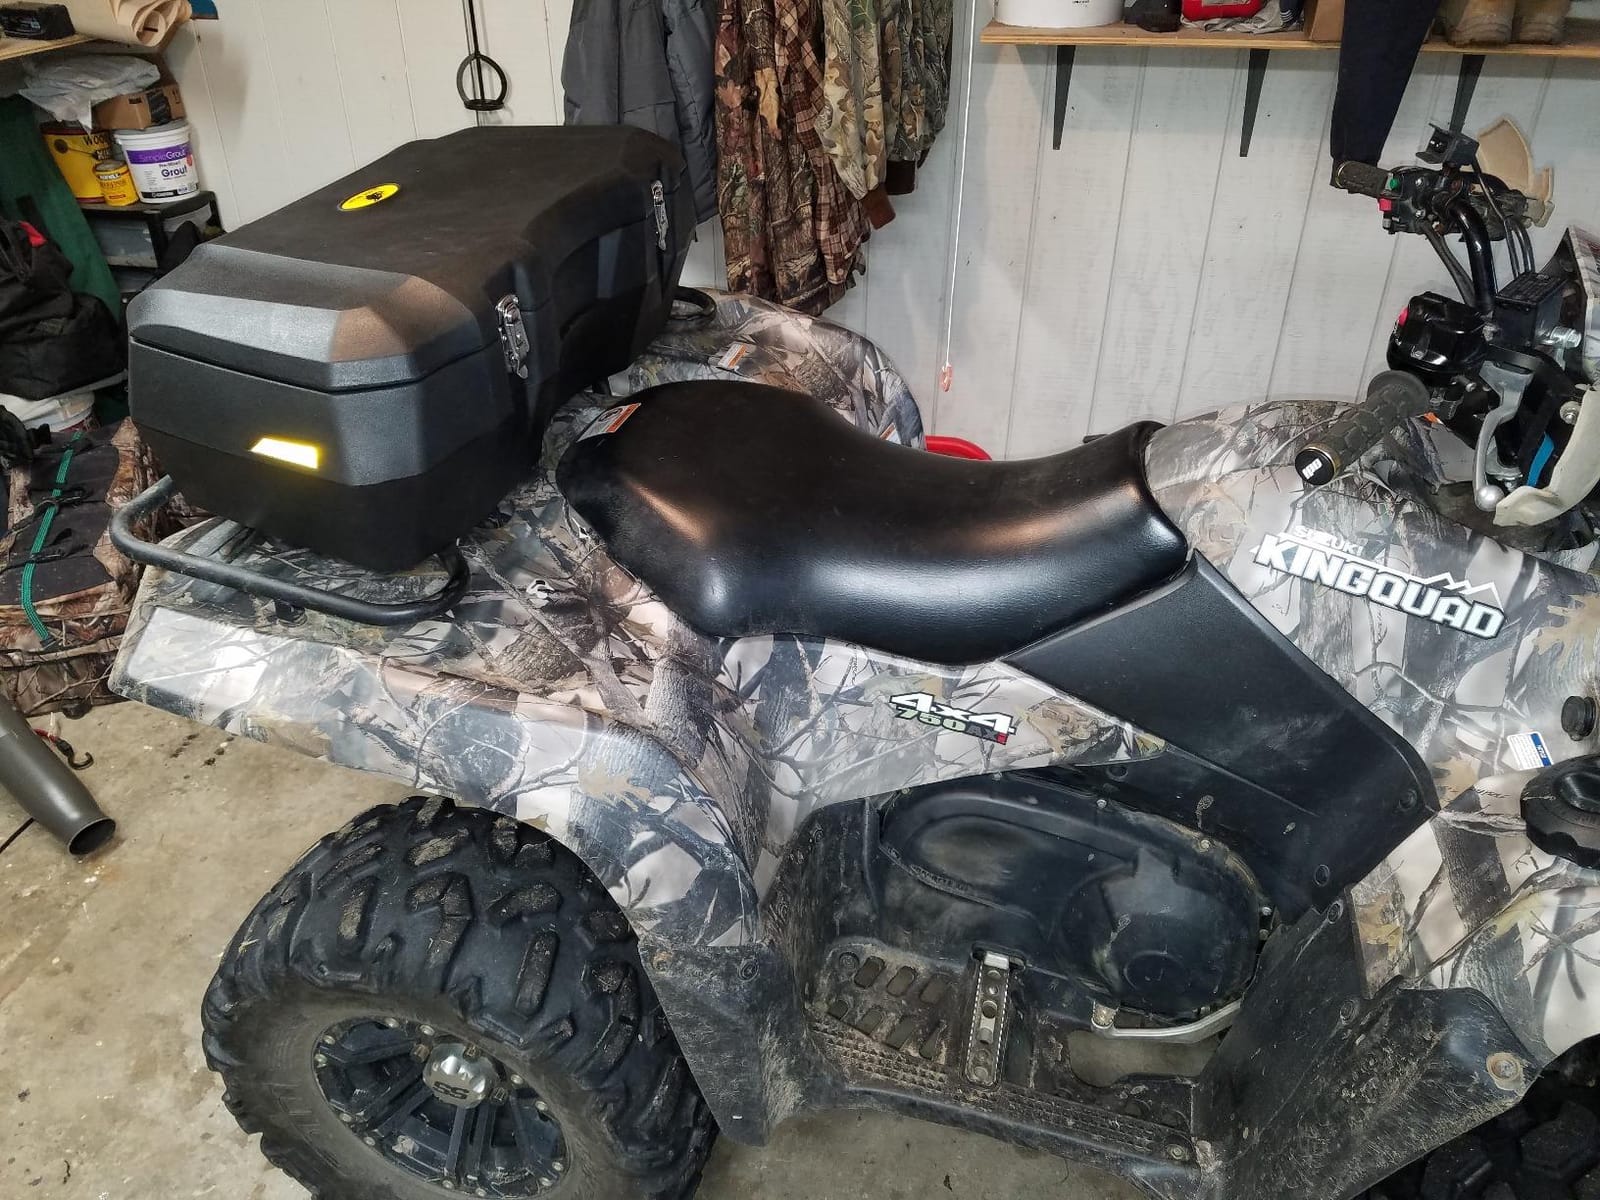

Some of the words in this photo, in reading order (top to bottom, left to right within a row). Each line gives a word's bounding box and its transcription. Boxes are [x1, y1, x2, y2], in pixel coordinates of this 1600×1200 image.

[161, 165, 188, 178] Grout
[1254, 534, 1505, 640] KINGQUAD
[895, 706, 967, 732] 750
